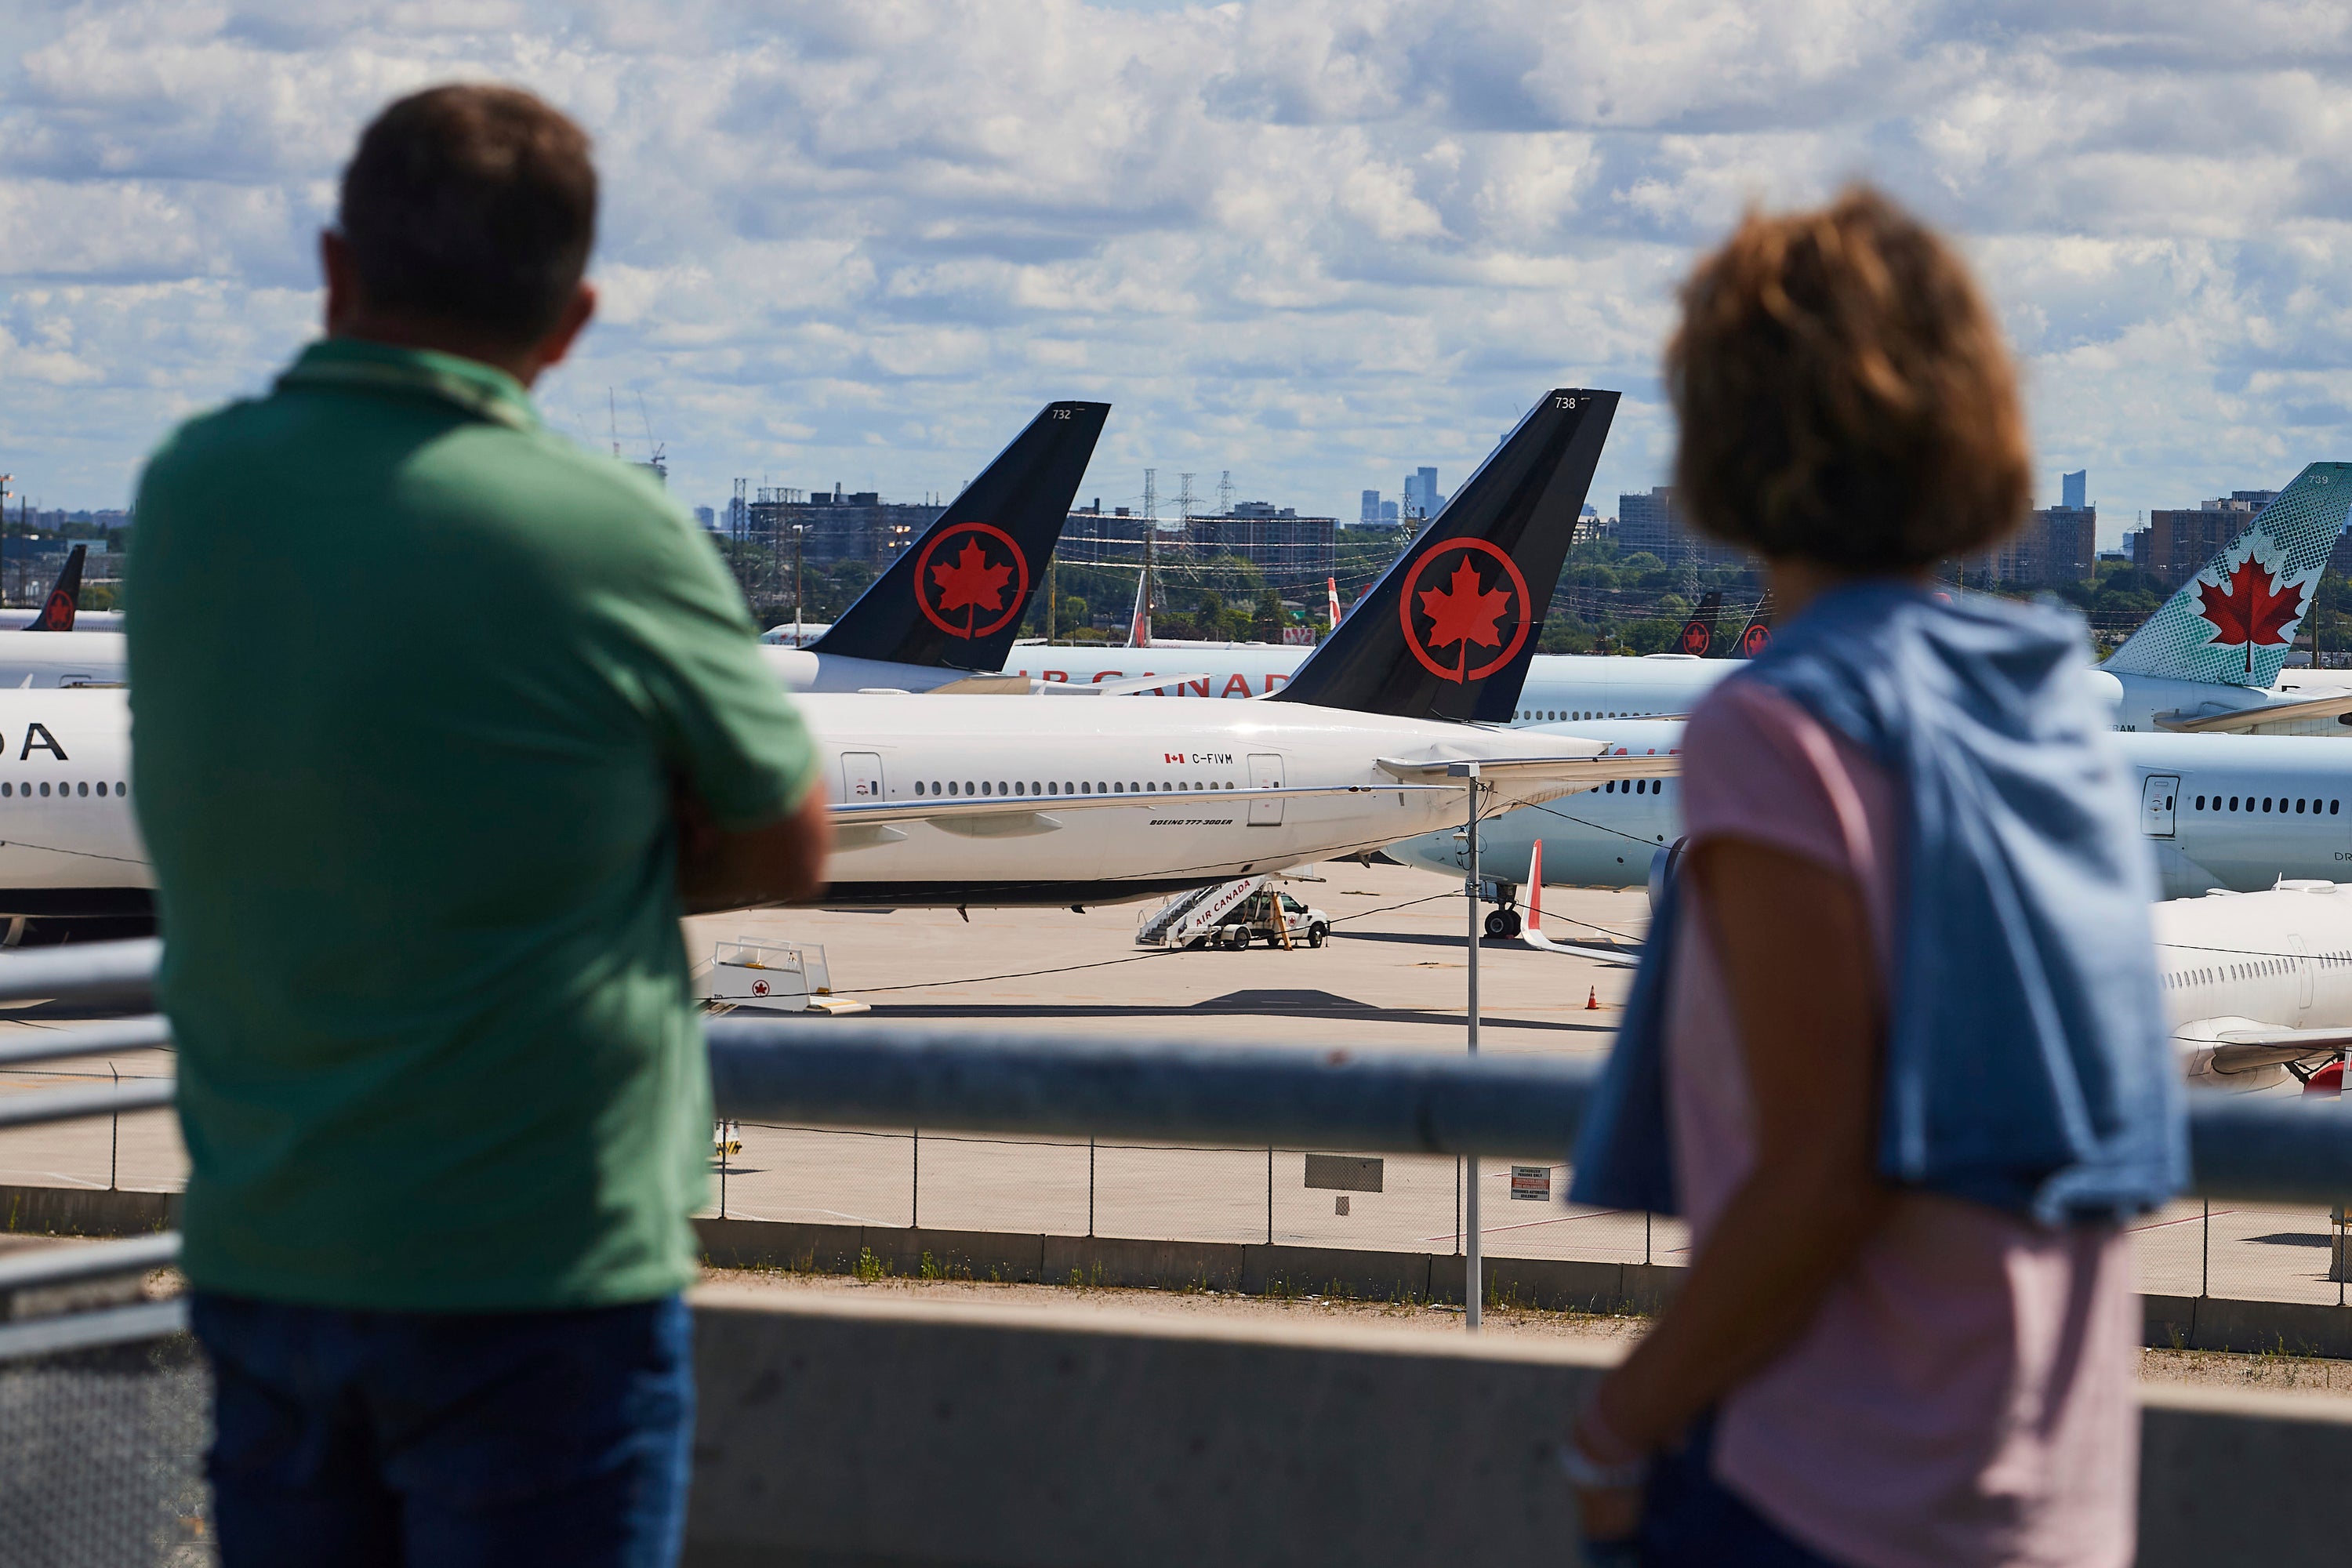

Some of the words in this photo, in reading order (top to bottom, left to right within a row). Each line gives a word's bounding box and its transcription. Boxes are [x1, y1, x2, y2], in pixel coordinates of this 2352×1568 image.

[1555, 397, 1576, 408] 738
[1053, 409, 1071, 419] 732
[2309, 475, 2328, 484] 739
[1192, 753, 1233, 764] C-FIVM
[1196, 909, 1212, 927] AIR
[1213, 880, 1250, 912] CANADA
